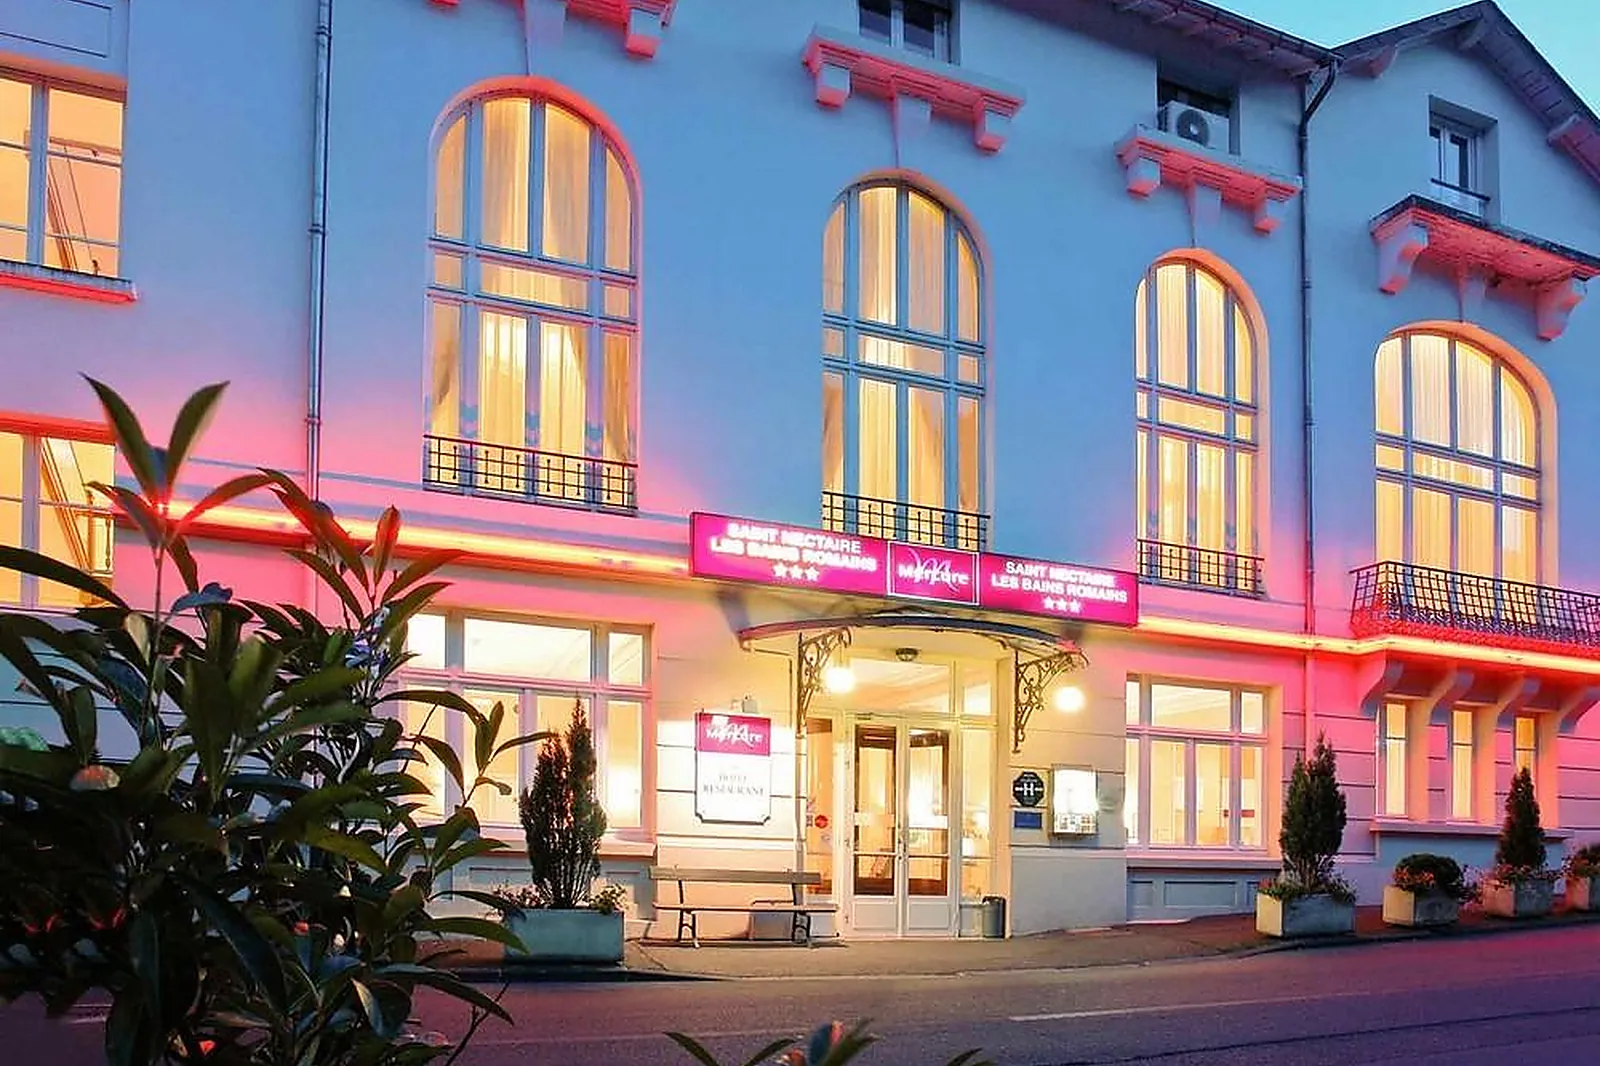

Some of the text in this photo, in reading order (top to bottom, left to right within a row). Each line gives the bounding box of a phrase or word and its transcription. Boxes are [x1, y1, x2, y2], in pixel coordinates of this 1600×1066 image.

[728, 523, 861, 552] SAINT NECTAIRE
[711, 537, 877, 572] LES BAINS ROMAINS
[897, 560, 969, 587] Mercure
[1005, 561, 1115, 587] SAINT NECTAIRE
[991, 574, 1128, 602] LES BAINS ROMAINS
